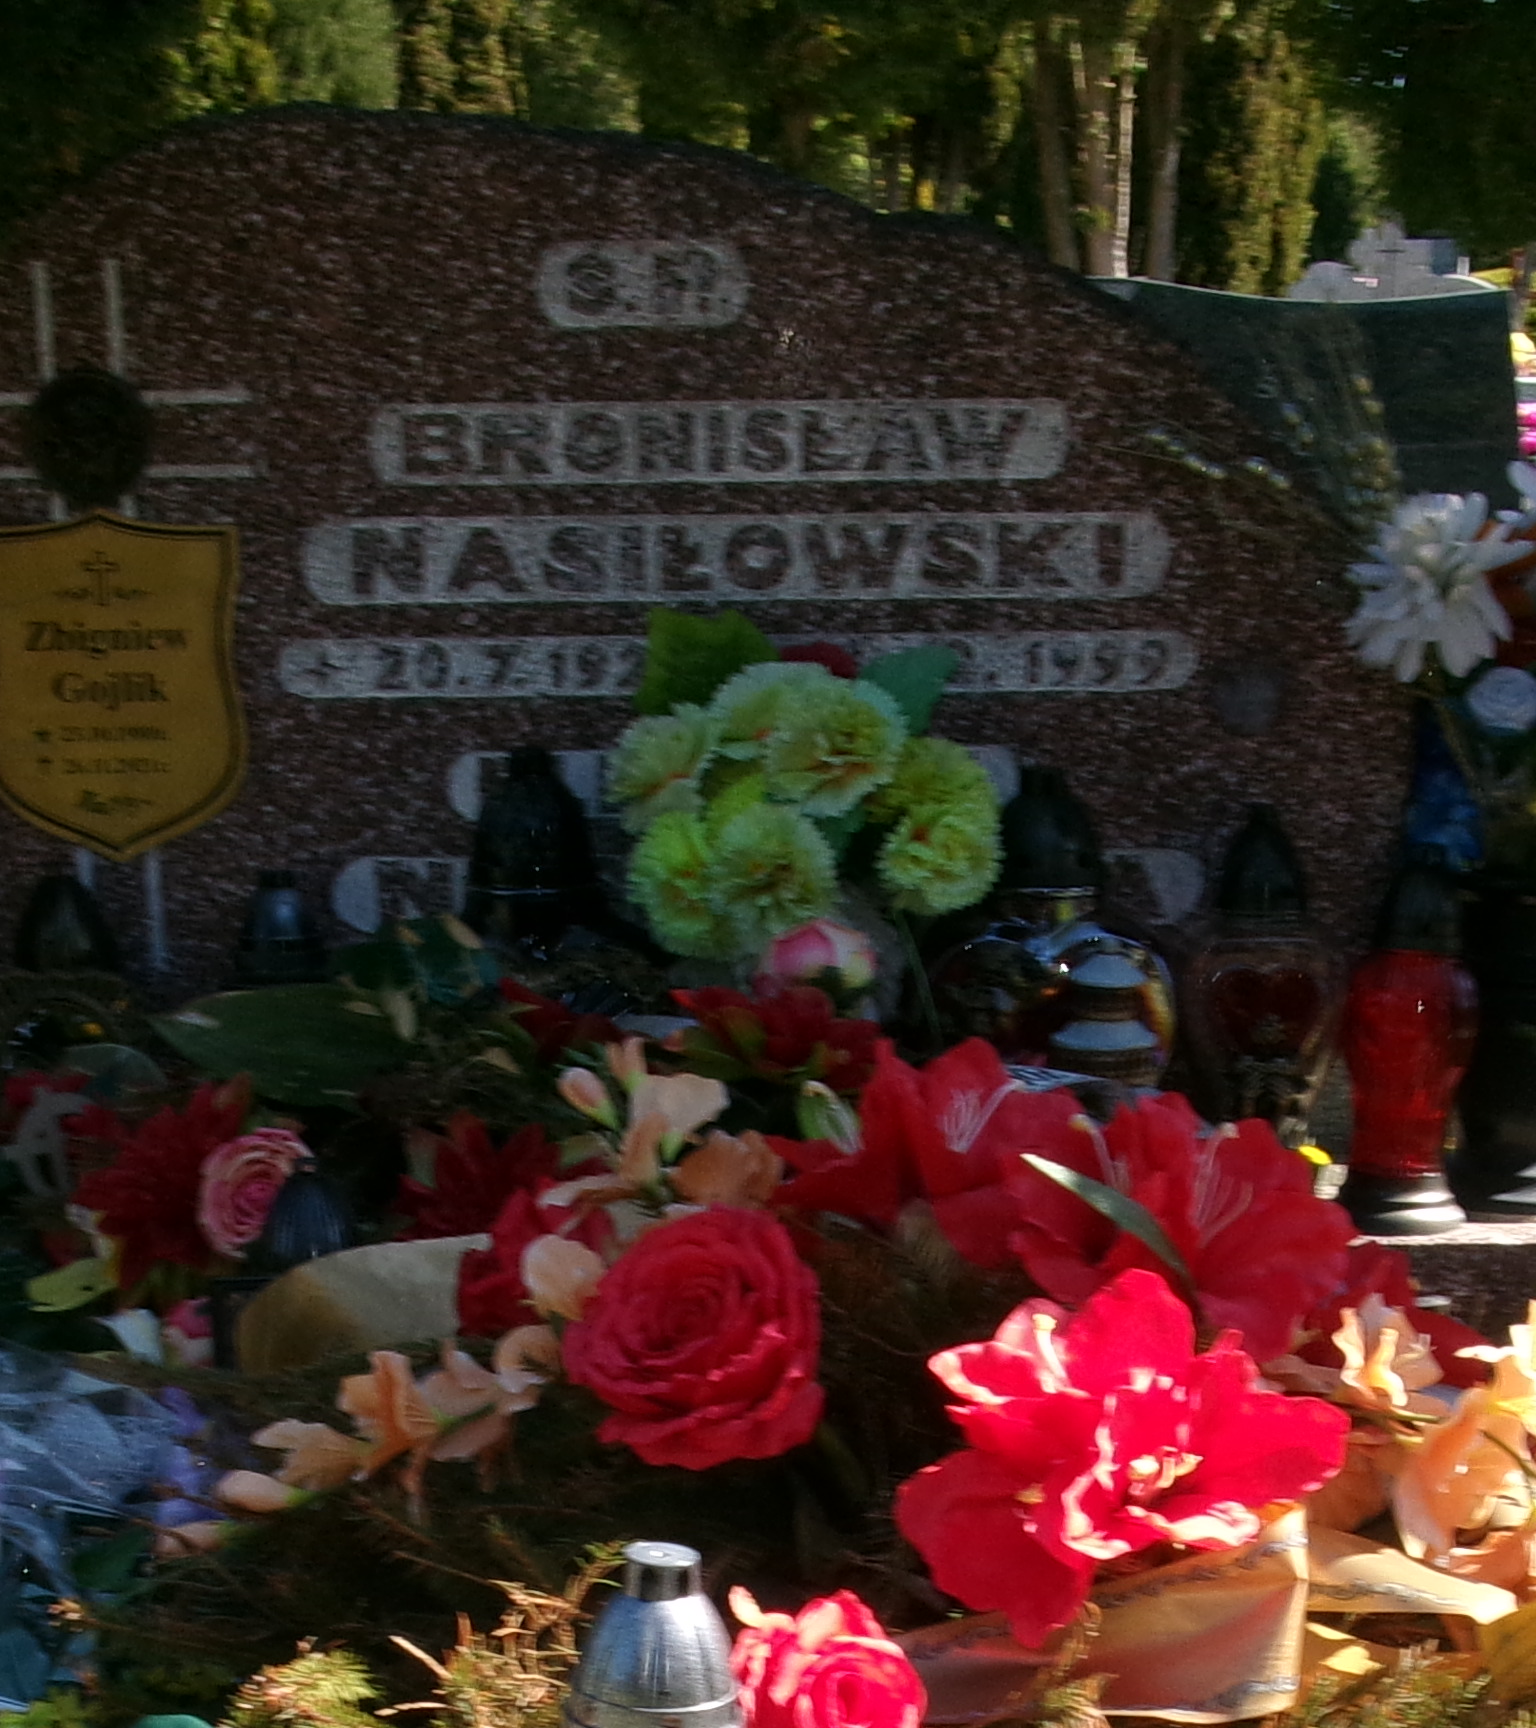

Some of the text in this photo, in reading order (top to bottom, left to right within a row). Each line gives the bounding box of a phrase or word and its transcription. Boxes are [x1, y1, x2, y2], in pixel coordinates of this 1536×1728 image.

[402, 407, 1027, 477] BRONISŁAW
[350, 520, 1125, 595] NASIŁOWSKI
[22, 620, 191, 660] Zbigniew
